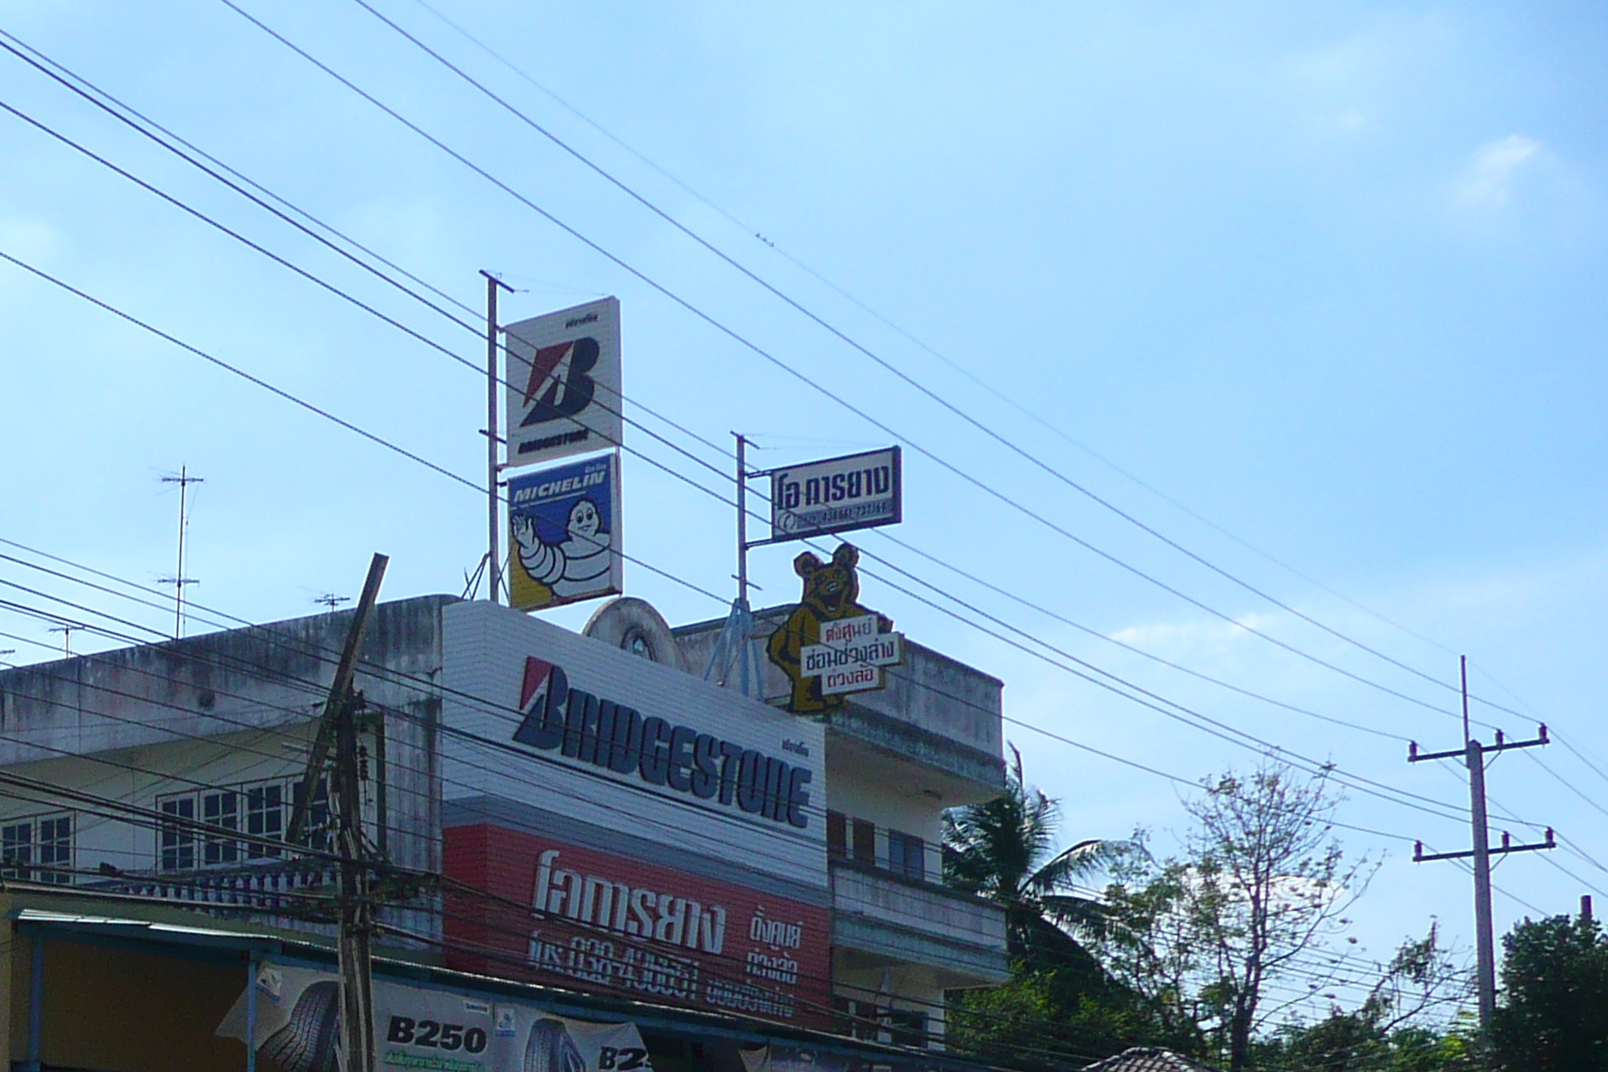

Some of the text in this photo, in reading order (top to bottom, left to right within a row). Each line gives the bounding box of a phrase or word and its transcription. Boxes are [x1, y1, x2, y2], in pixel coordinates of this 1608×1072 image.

[513, 470, 606, 504] MICHELIN
[804, 464, 890, 507] การยาง
[512, 655, 813, 830] BRIDGESTONE
[749, 904, 804, 953] ตั้งศูนย์
[387, 1014, 488, 1054] B250
[598, 1045, 653, 1072] B2
